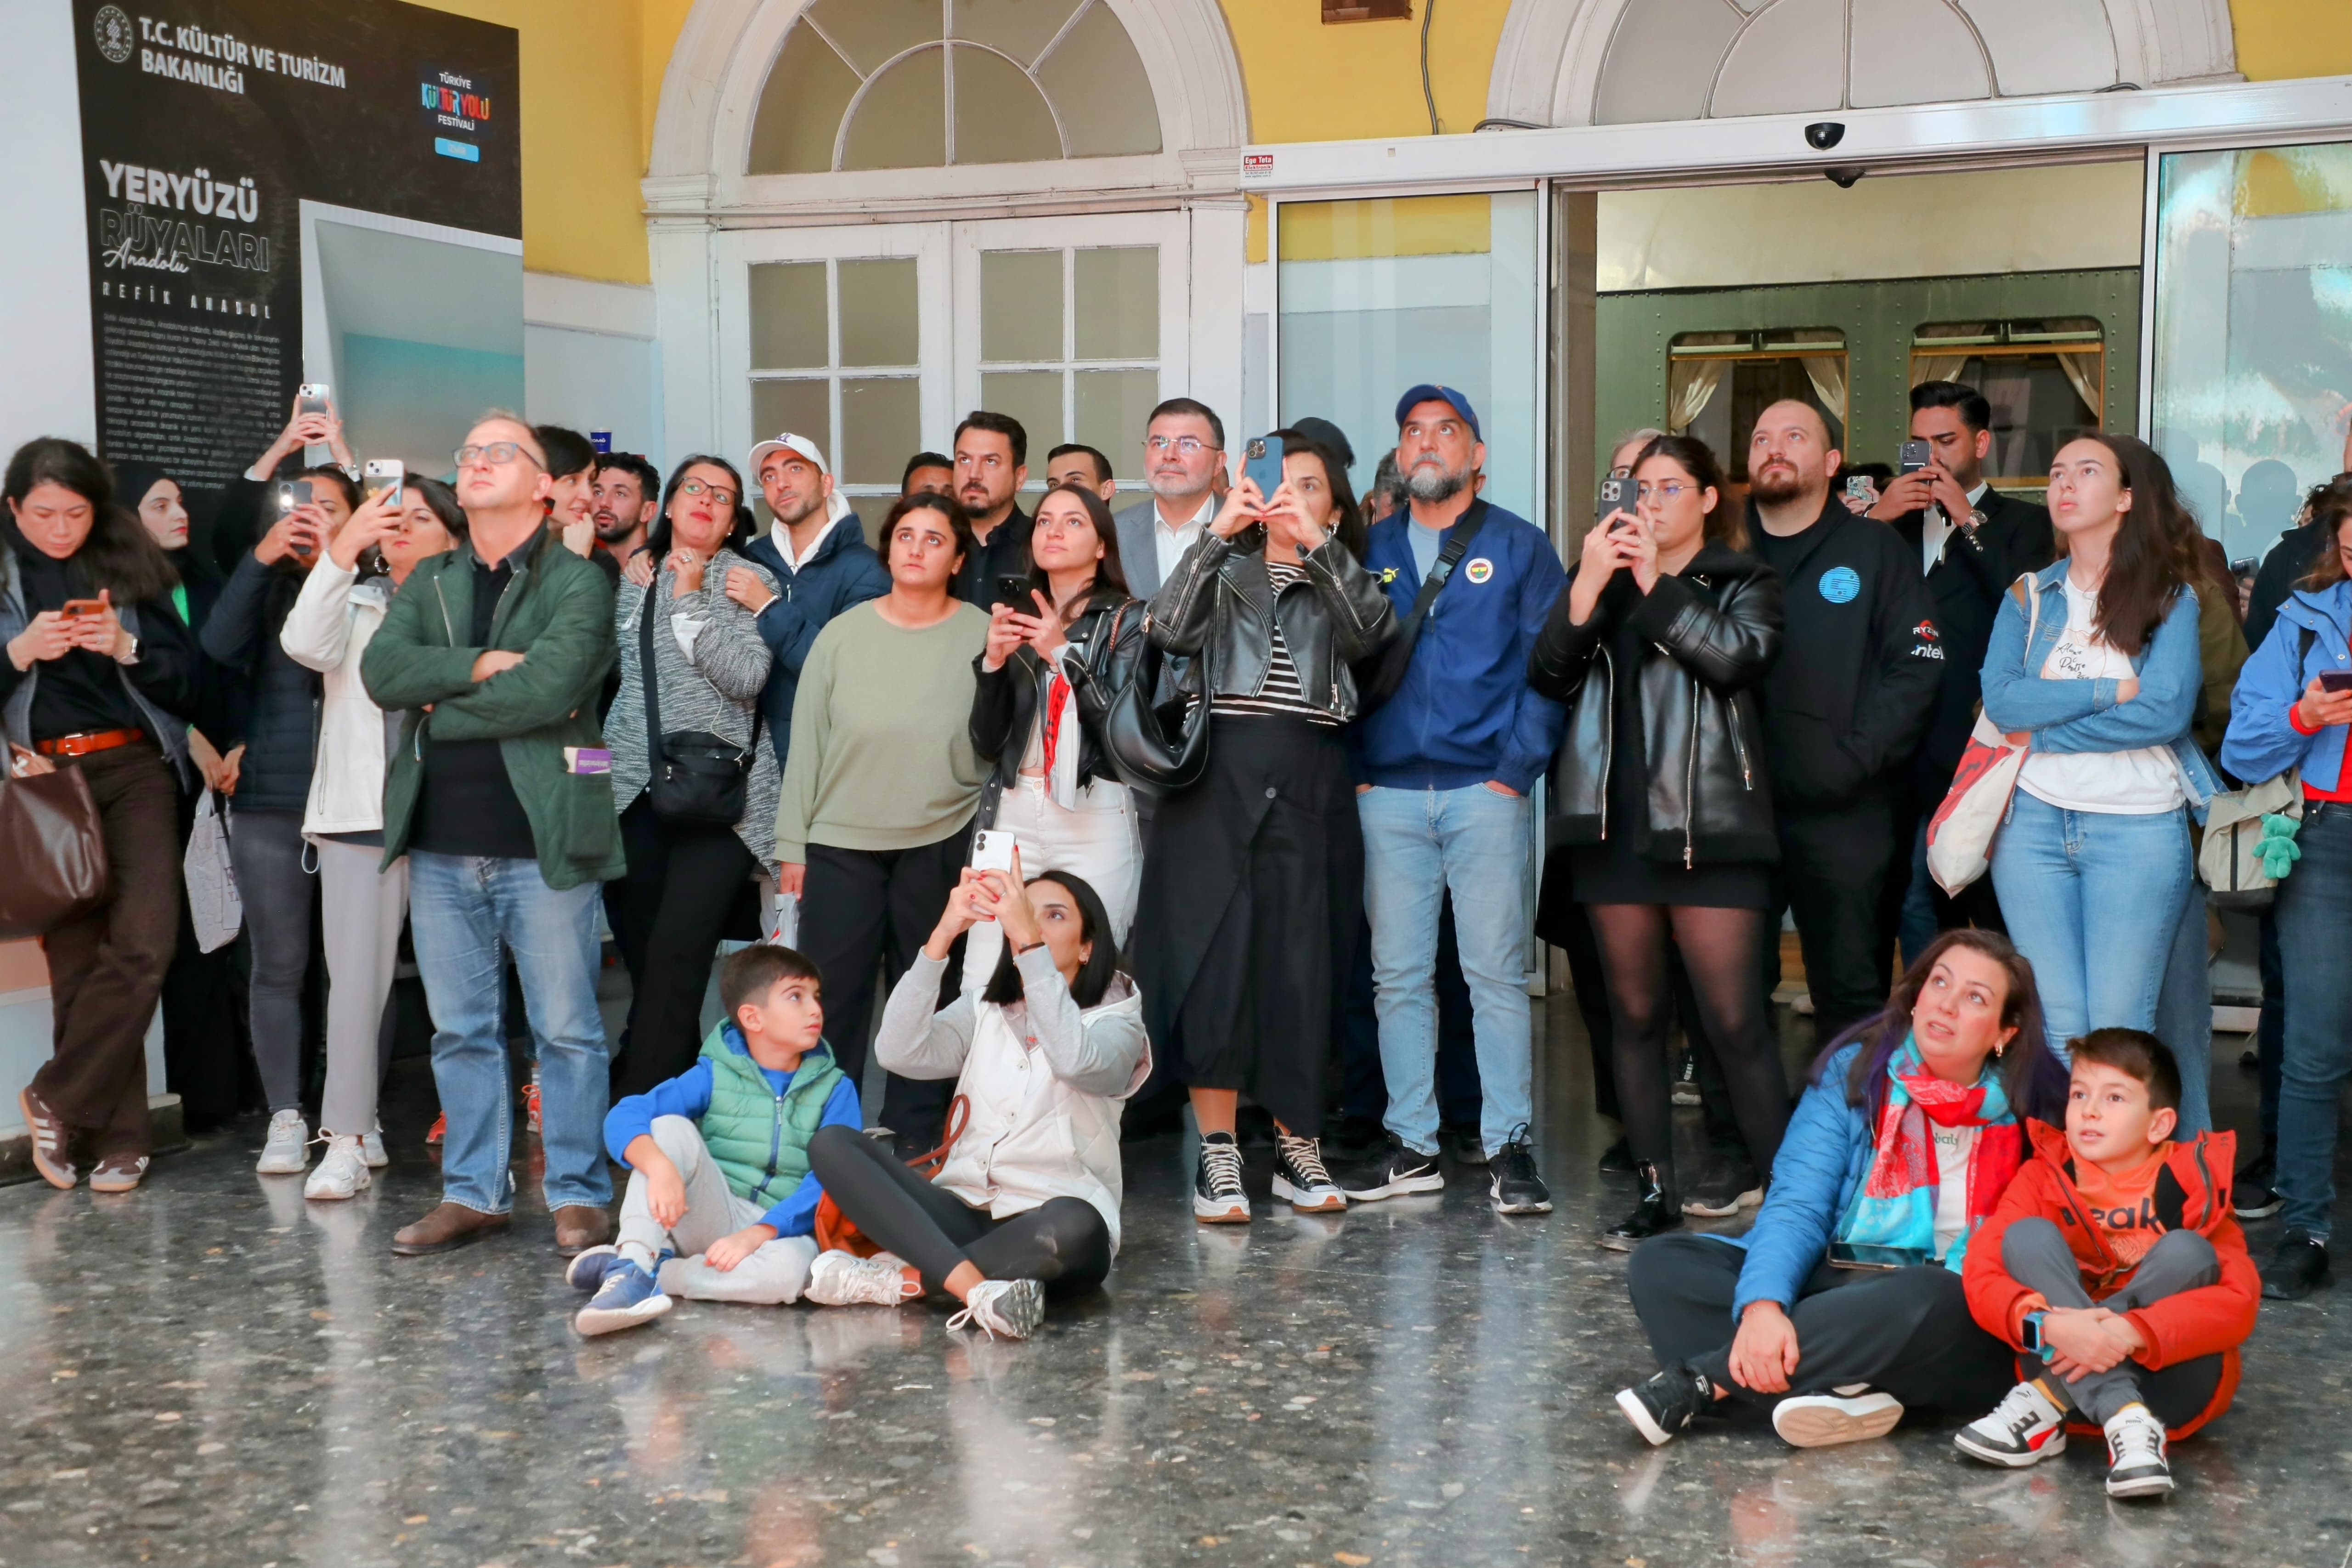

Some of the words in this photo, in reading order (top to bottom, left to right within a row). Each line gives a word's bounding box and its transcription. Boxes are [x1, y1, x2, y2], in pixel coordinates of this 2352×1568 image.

[139, 17, 174, 46] T.C.
[176, 25, 249, 66] KÜLTÜR
[251, 45, 276, 72] VE
[278, 52, 346, 89] TURİZM
[141, 48, 244, 94] BAKANLIĞI
[439, 72, 472, 90] TÜRKİYE
[438, 114, 475, 131] FESTİVALİ
[1245, 157, 1257, 165] Ege
[99, 159, 258, 222] YERYÜZÜ
[101, 203, 269, 272] RÜYALARI
[102, 237, 190, 273] Anadolu
[103, 281, 171, 305] REFİK
[191, 294, 271, 319] ANADOL
